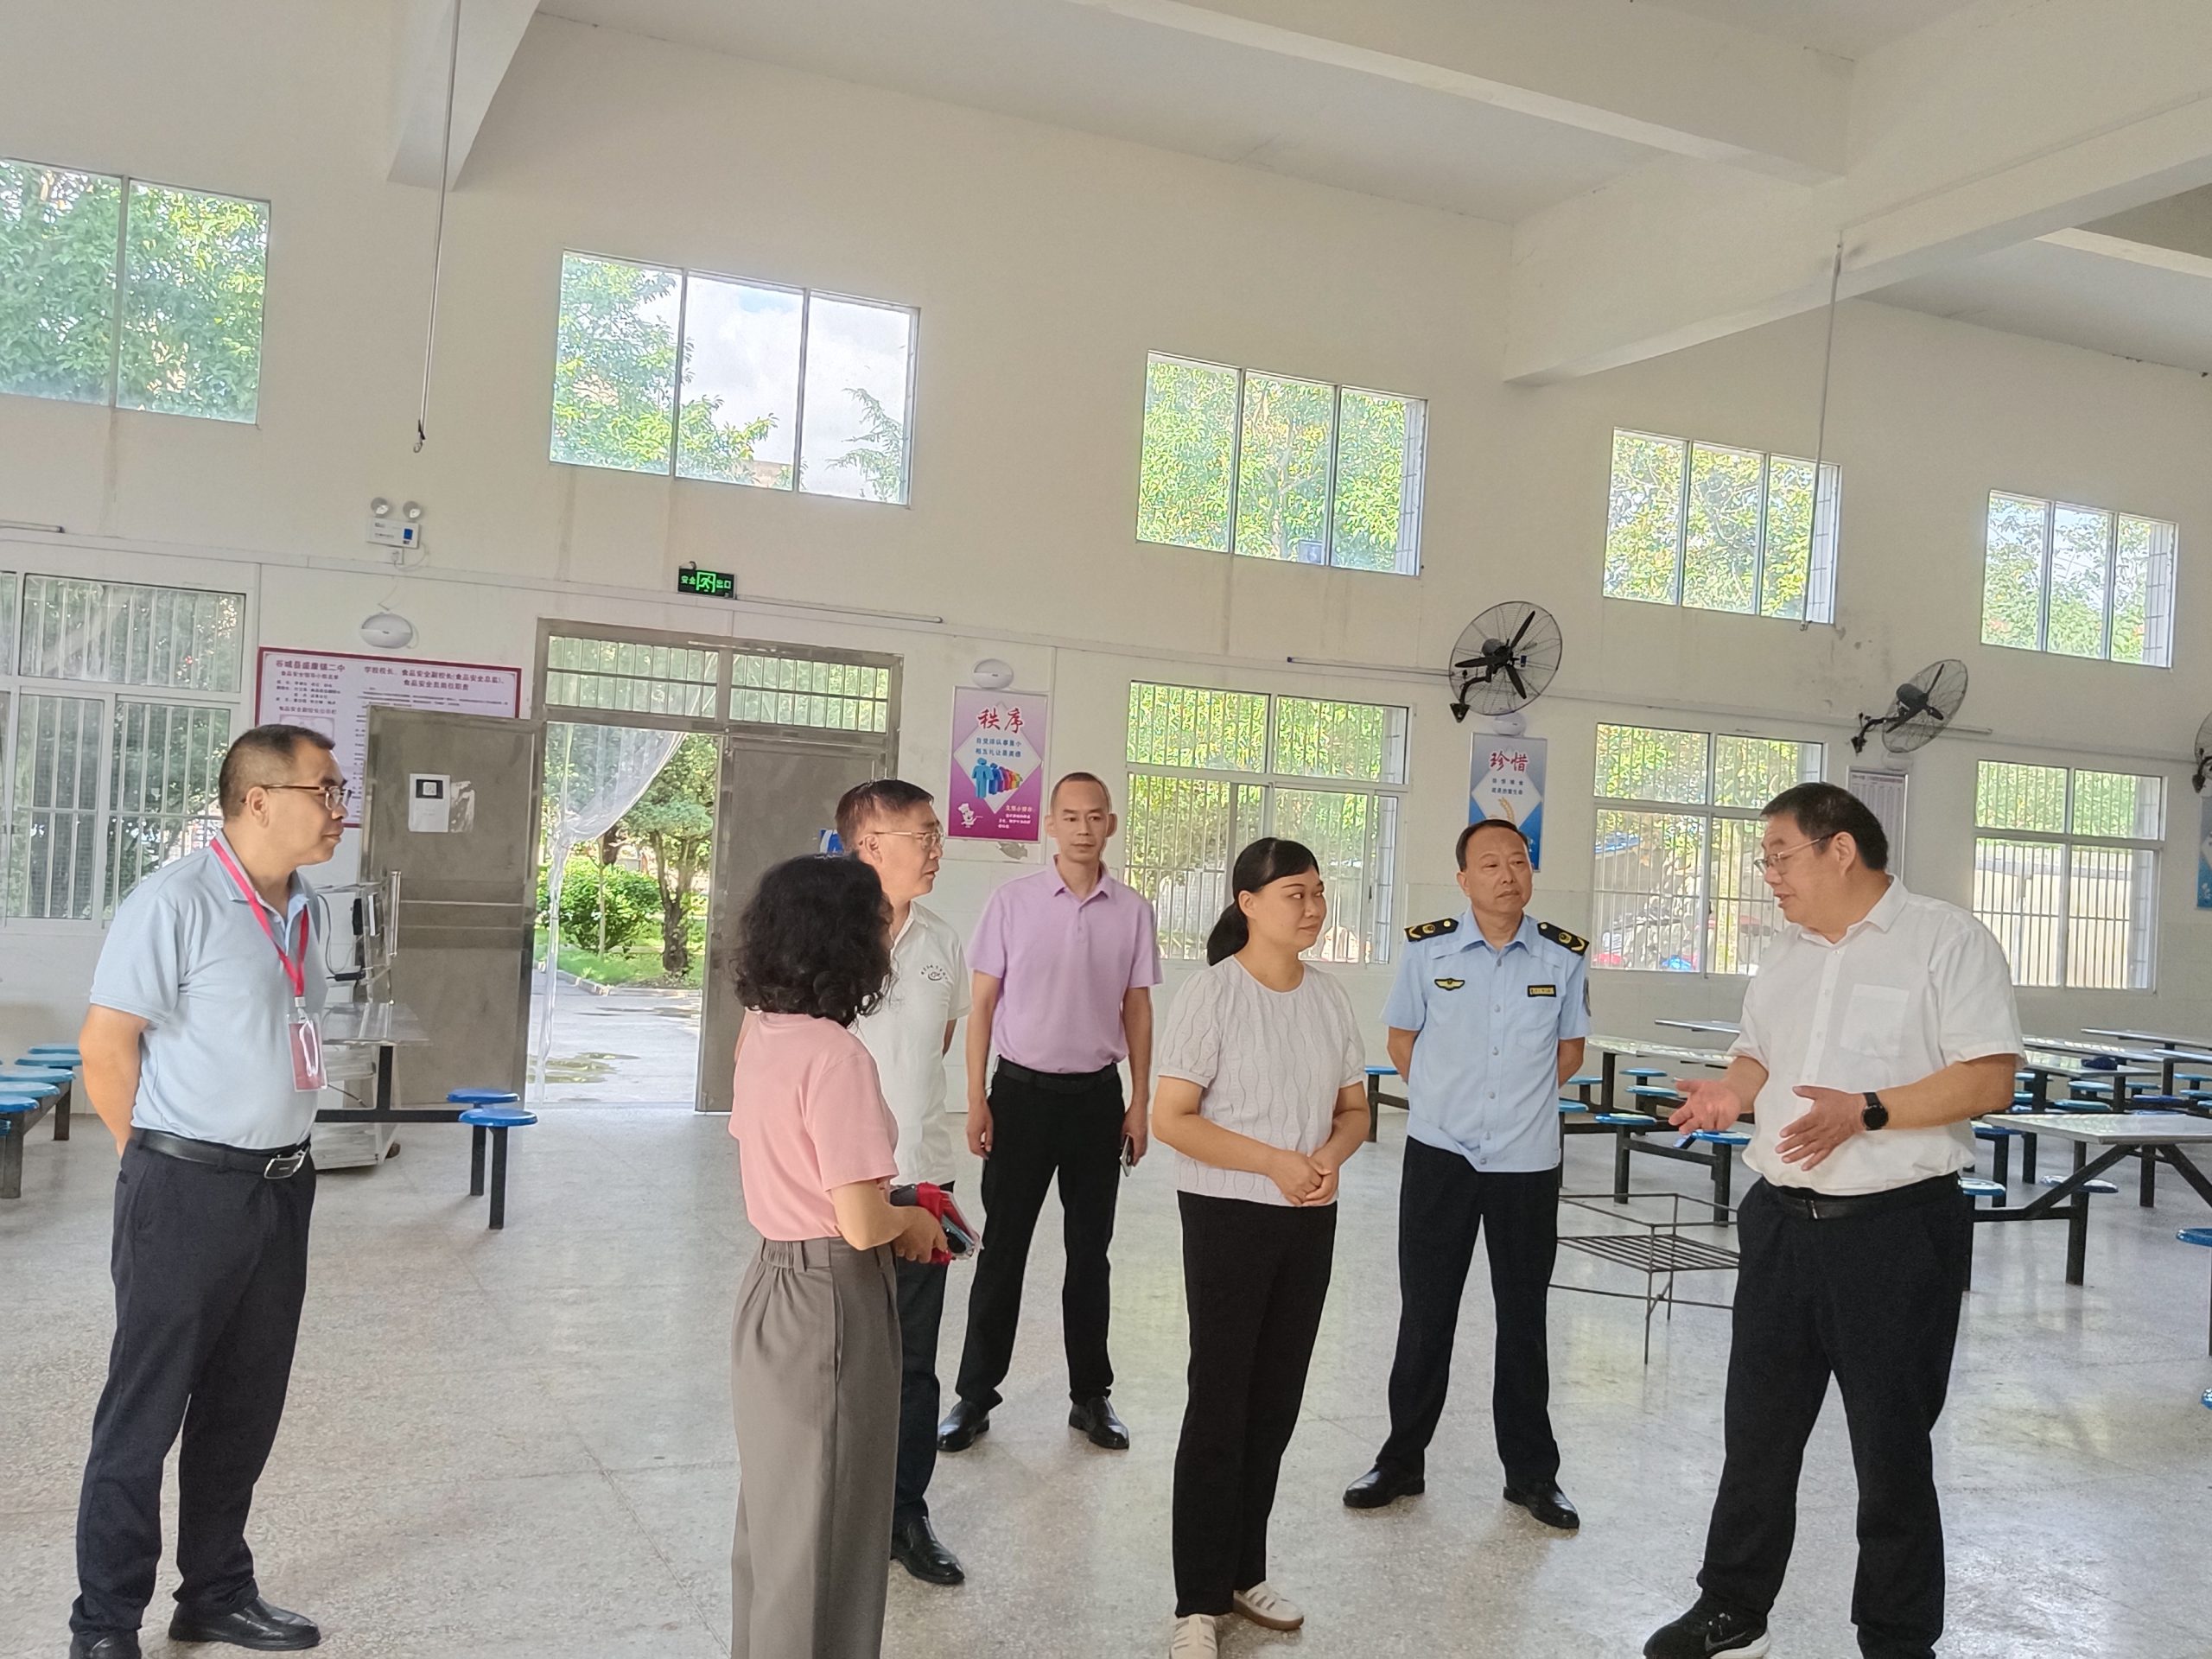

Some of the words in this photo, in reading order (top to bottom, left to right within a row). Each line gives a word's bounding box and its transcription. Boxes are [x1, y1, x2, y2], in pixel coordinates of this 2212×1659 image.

[681, 575, 696, 585] 安全
[716, 579, 732, 588] 出口
[978, 708, 1023, 734] 秩序
[1491, 750, 1528, 772] 珍惜
